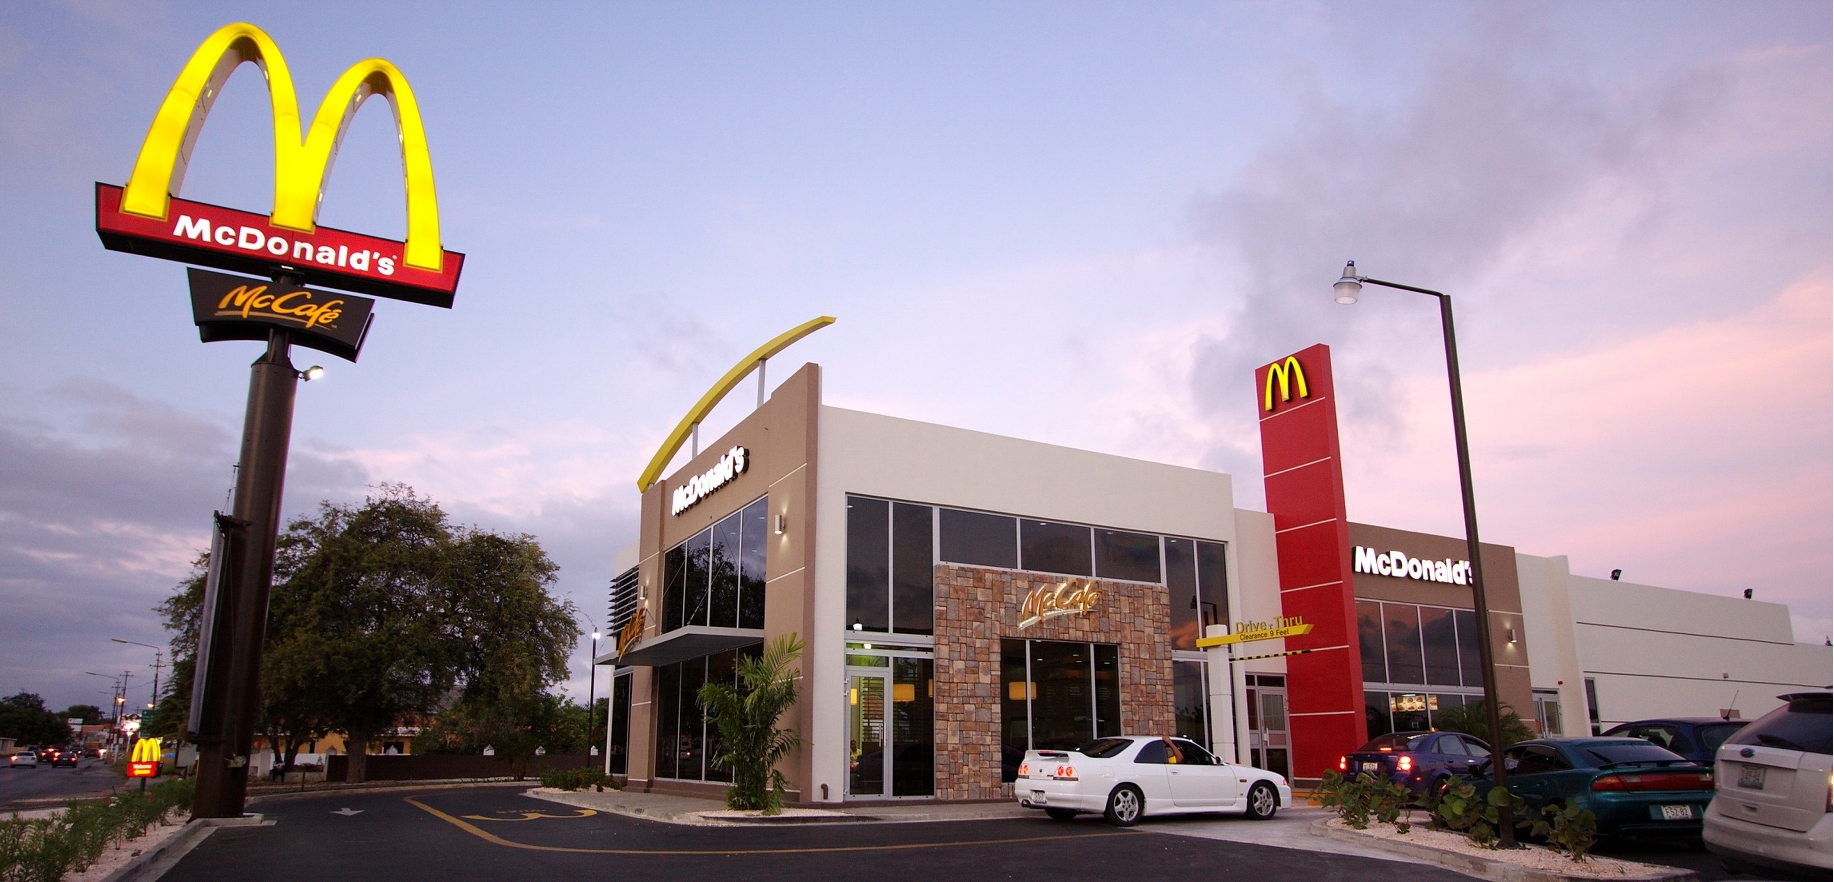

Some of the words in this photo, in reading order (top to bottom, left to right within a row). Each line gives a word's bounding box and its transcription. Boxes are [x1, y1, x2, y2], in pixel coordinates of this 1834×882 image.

[173, 214, 395, 275] McDonald's
[218, 285, 343, 328] McCafé
[672, 445, 745, 516] McDonald's
[1236, 619, 1267, 634] Drive
[1273, 615, 1303, 630] Thru
[1240, 631, 1268, 641] Clearance
[1275, 628, 1290, 636] Feet
